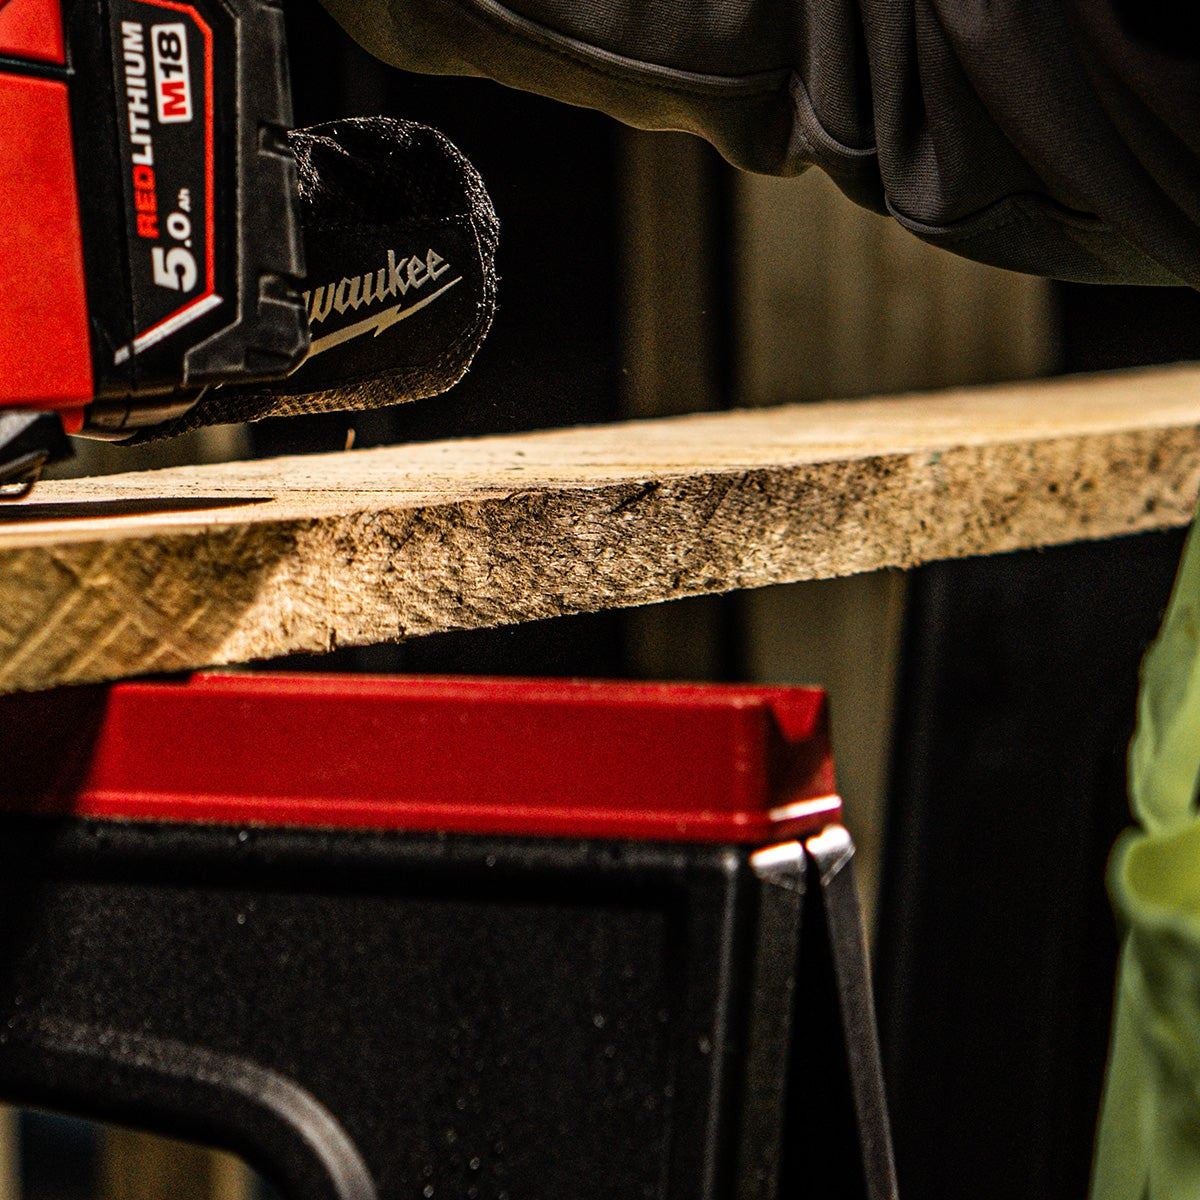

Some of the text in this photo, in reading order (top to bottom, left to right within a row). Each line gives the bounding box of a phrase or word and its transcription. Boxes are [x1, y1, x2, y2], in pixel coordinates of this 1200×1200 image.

[156, 30, 188, 119] M18
[121, 21, 160, 239] REDLITHIUM
[302, 249, 450, 325] waukee
